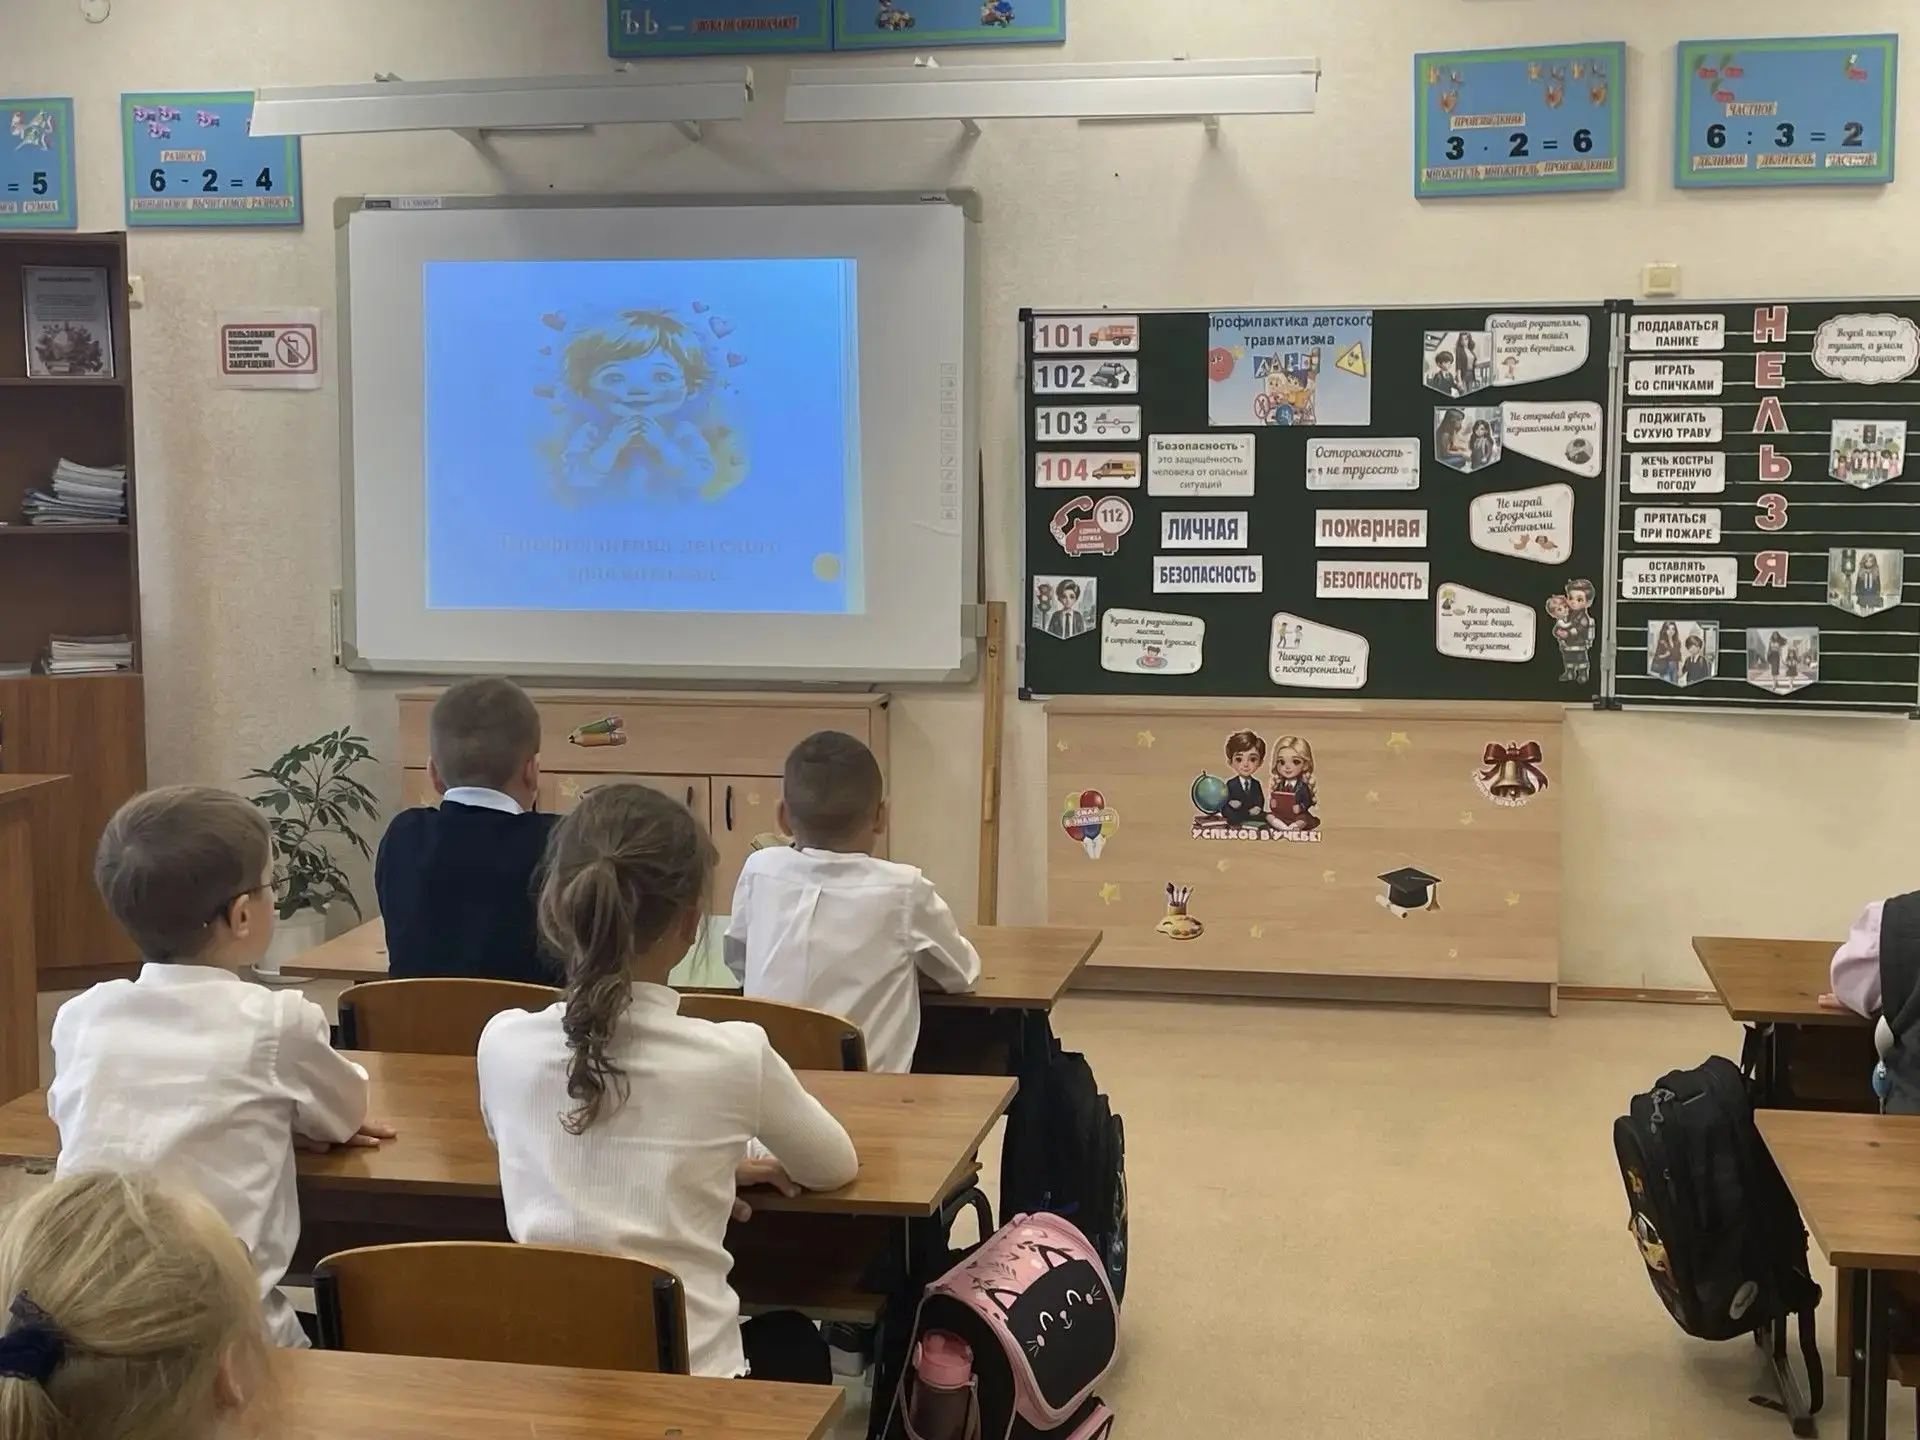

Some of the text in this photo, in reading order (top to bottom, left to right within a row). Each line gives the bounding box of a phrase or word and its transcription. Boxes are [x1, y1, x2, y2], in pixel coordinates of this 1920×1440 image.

[1707, 123, 1726, 148] 6
[1774, 122, 1795, 148] 3
[1841, 121, 1864, 146] 2
[1445, 136, 1465, 160] 3
[1508, 132, 1529, 157] 2
[1573, 128, 1593, 153] 6
[32, 172, 48, 195] 5
[150, 168, 166, 192] 6
[202, 169, 218, 192] 2
[256, 167, 272, 191] 4
[1313, 315, 1373, 328] детского
[1637, 320, 1719, 332] ПОДДАВАТЬСЯ
[1039, 324, 1083, 348] 101
[1244, 335, 1335, 347] травматизма
[1655, 336, 1700, 347] ПАНИКЕ
[1655, 365, 1695, 375] ИГРАТЬ
[1038, 365, 1086, 389] 102
[1635, 380, 1714, 391] СО СПИЧКАМИ
[1040, 411, 1088, 435] 103
[1639, 412, 1706, 424] ПОДЖИГАТЬ
[1633, 428, 1711, 439] СУХУЮ ТРАВУ
[1157, 441, 1238, 450] Безопасность
[1641, 456, 1714, 465] ЖЕЧЬ КОСТРЫ
[1042, 458, 1088, 481] 104
[1326, 466, 1399, 480] не трусость
[1642, 468, 1712, 478] В ВЕТРЕННУЮ
[1180, 481, 1222, 492] ситуаций
[1657, 481, 1696, 491] ПОГОДУ
[1513, 496, 1542, 511] играй
[1101, 508, 1123, 522] 112
[1495, 510, 1552, 524] бродячими
[1643, 513, 1707, 523] ПРЯТАТЬСЯ
[1168, 518, 1238, 540] ЛИЧНАЯ
[1321, 518, 1420, 542] пожарная
[1640, 529, 1712, 539] ПРИ ПОЖАРЕ
[1649, 562, 1705, 571] ОСТАВЛЯТЬ
[1160, 566, 1256, 583] БЕЗОПАСНОСТЬ
[1323, 571, 1422, 589] БЕЗОПАСНОСТЬ
[1638, 574, 1719, 583] БЕЗ ПРИСМОТРА
[1632, 587, 1725, 596] ЭЛЕКТРОПРИБОРЫ
[1328, 655, 1350, 665] ходи
[1192, 828, 1258, 840] УСПЕХОВ
[1260, 829, 1270, 840] В
